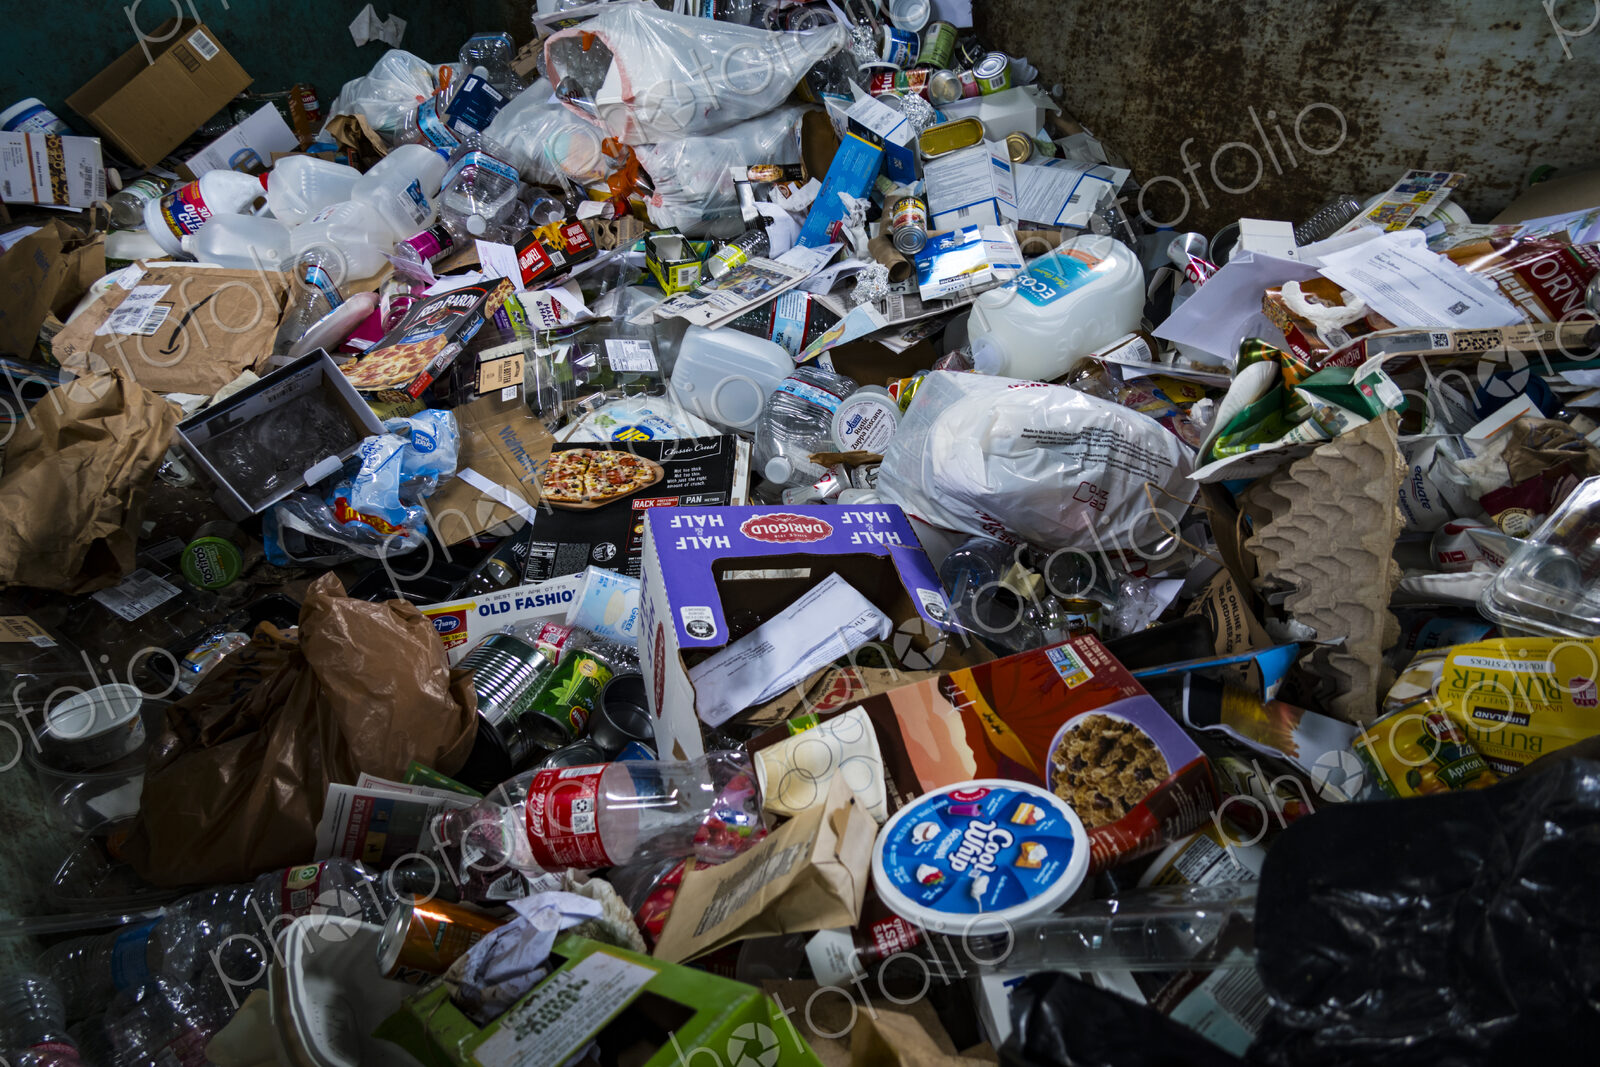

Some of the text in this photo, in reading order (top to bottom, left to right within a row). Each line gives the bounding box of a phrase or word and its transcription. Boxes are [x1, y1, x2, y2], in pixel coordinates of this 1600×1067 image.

[1013, 274, 1056, 300] ECOS
[415, 293, 479, 321] RED BARON
[851, 408, 884, 450] Zuppa Toscana
[854, 417, 870, 436] Rustic
[664, 442, 718, 456] Classic Crust
[1413, 464, 1432, 513] equate
[634, 499, 654, 509] RACK
[686, 495, 702, 504] PAN
[670, 514, 724, 528] HALF
[841, 512, 891, 525] HALF
[751, 523, 824, 535] DARIGOLD
[676, 536, 731, 550] HALF
[851, 532, 902, 546] HALF
[478, 601, 512, 618] OLD
[1228, 594, 1241, 632] ONLINE
[433, 616, 460, 632] Franz
[624, 606, 640, 632] GREEK
[1234, 632, 1242, 645] AT
[1470, 658, 1499, 666] STICKS
[1452, 668, 1562, 700] BUTTER
[1475, 710, 1527, 725] KIRKLAND
[1448, 758, 1482, 778] Apricot
[530, 792, 546, 838] Coca-Cola
[949, 820, 997, 872] Whip
[976, 828, 1014, 873] Cool
